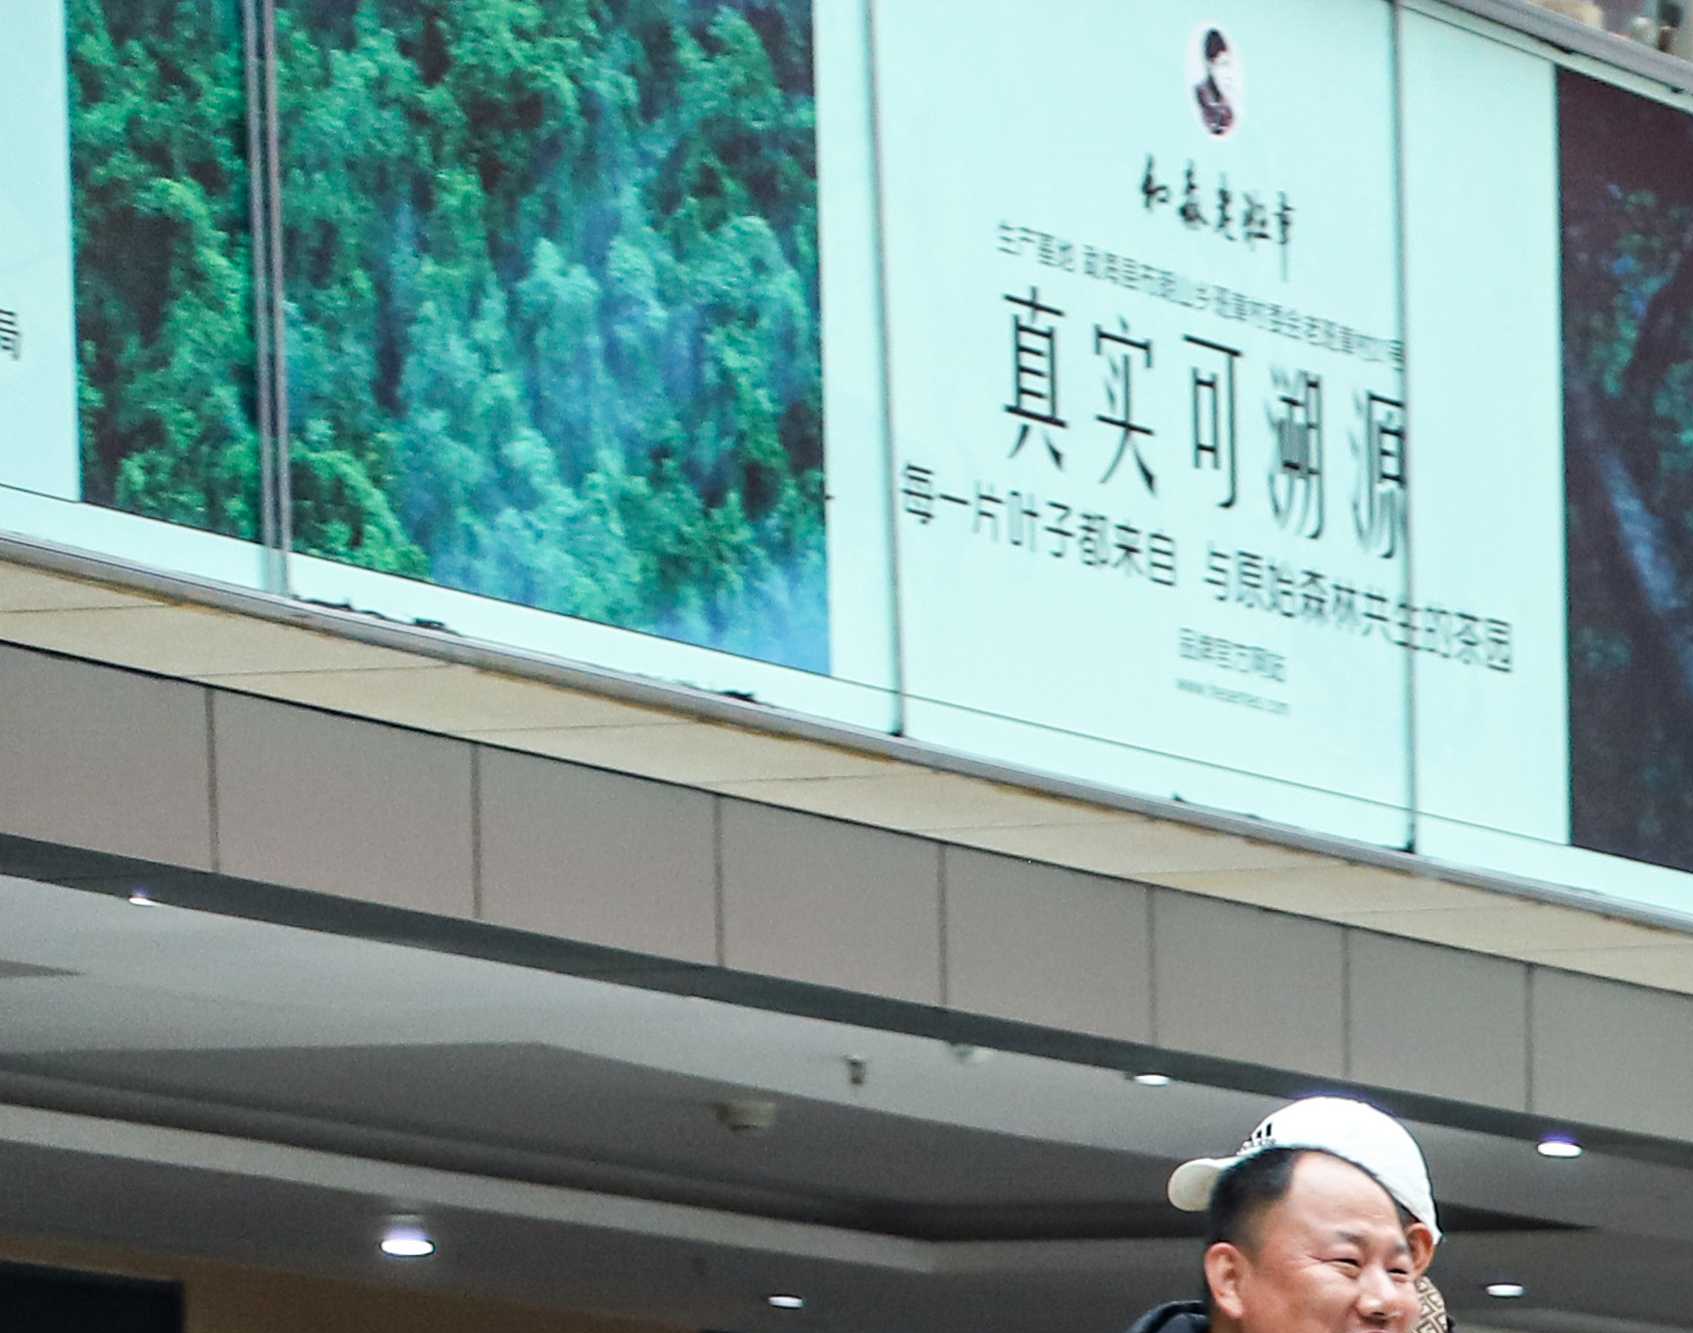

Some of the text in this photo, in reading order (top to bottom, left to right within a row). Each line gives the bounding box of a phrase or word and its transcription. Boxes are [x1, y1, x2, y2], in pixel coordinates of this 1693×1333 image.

[1000, 287, 1406, 559] 真实可溯源
[900, 463, 1177, 587] 每一片叶子都来自
